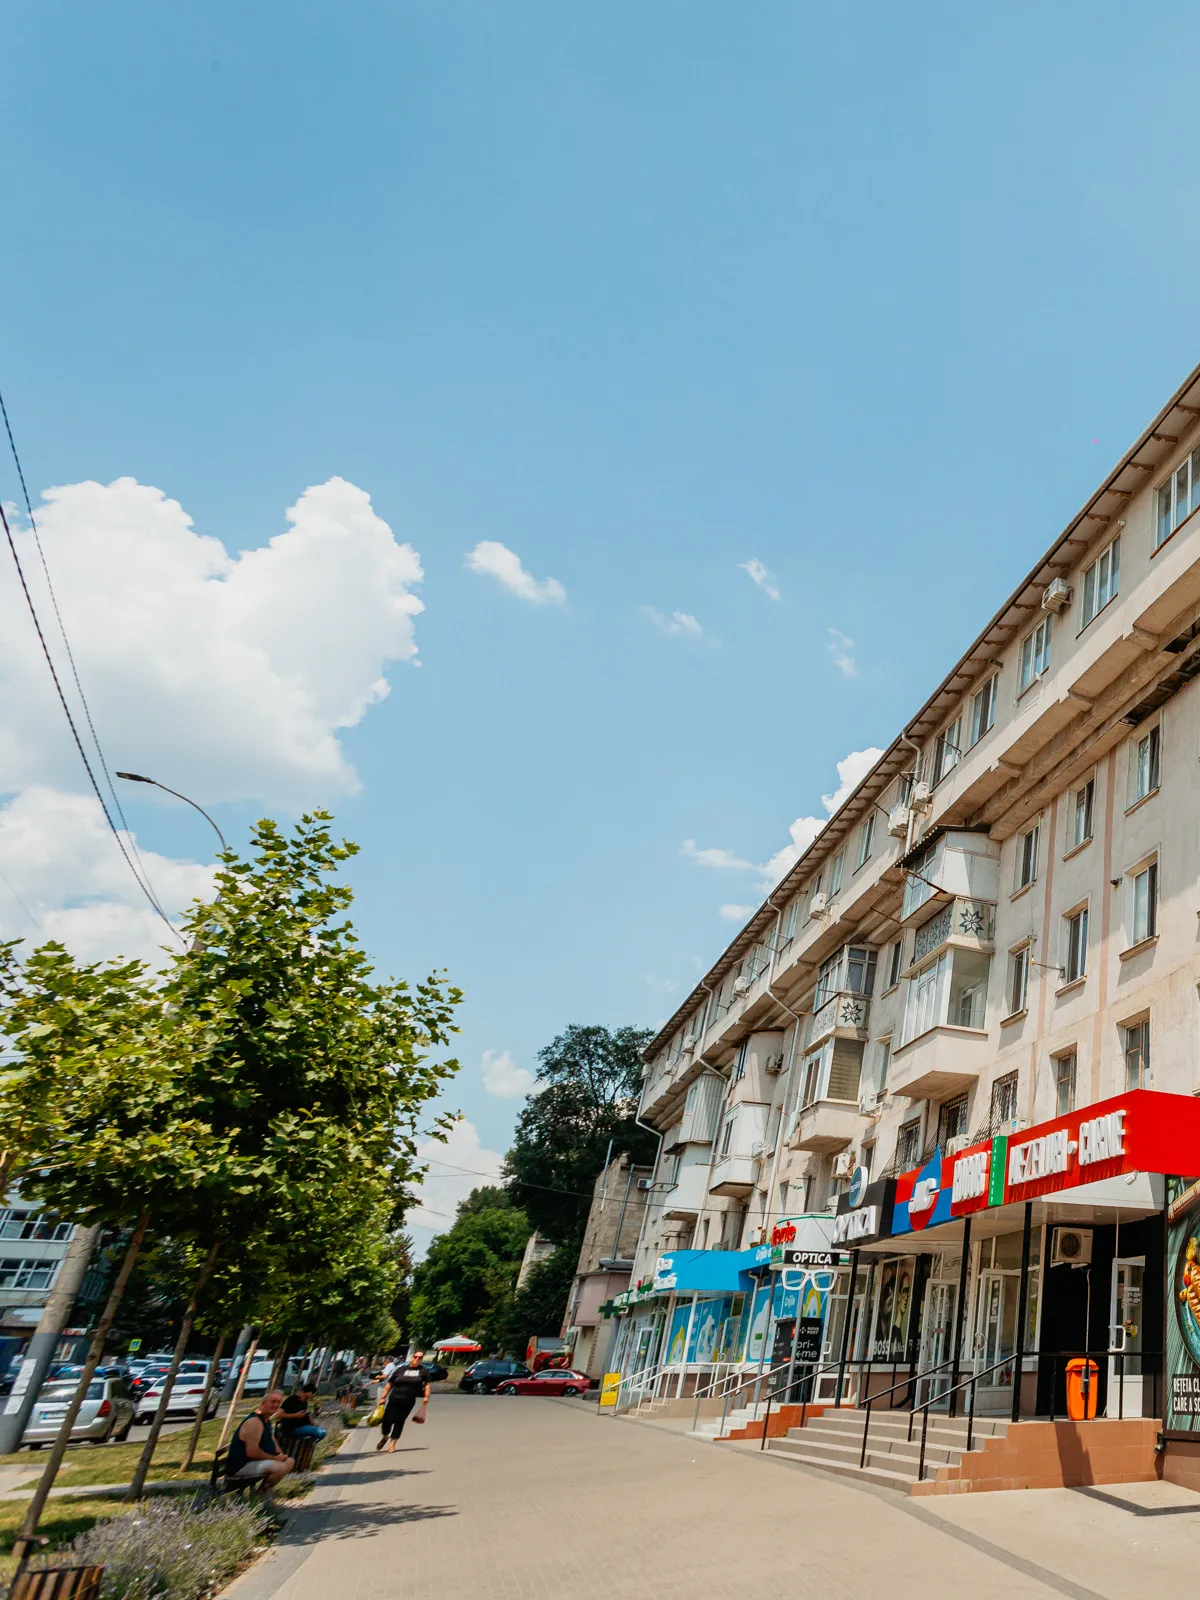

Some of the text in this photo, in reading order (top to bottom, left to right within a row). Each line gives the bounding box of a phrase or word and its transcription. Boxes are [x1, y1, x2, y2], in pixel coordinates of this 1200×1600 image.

[1008, 1110, 1127, 1186] MEZELURI CARNE
[832, 1205, 877, 1243] OPTICA
[792, 1252, 832, 1264] OPTICA
[1173, 1377, 1193, 1396] REȚETA
[1173, 1396, 1187, 1412] CARE
[1189, 1398, 1193, 1412] A
